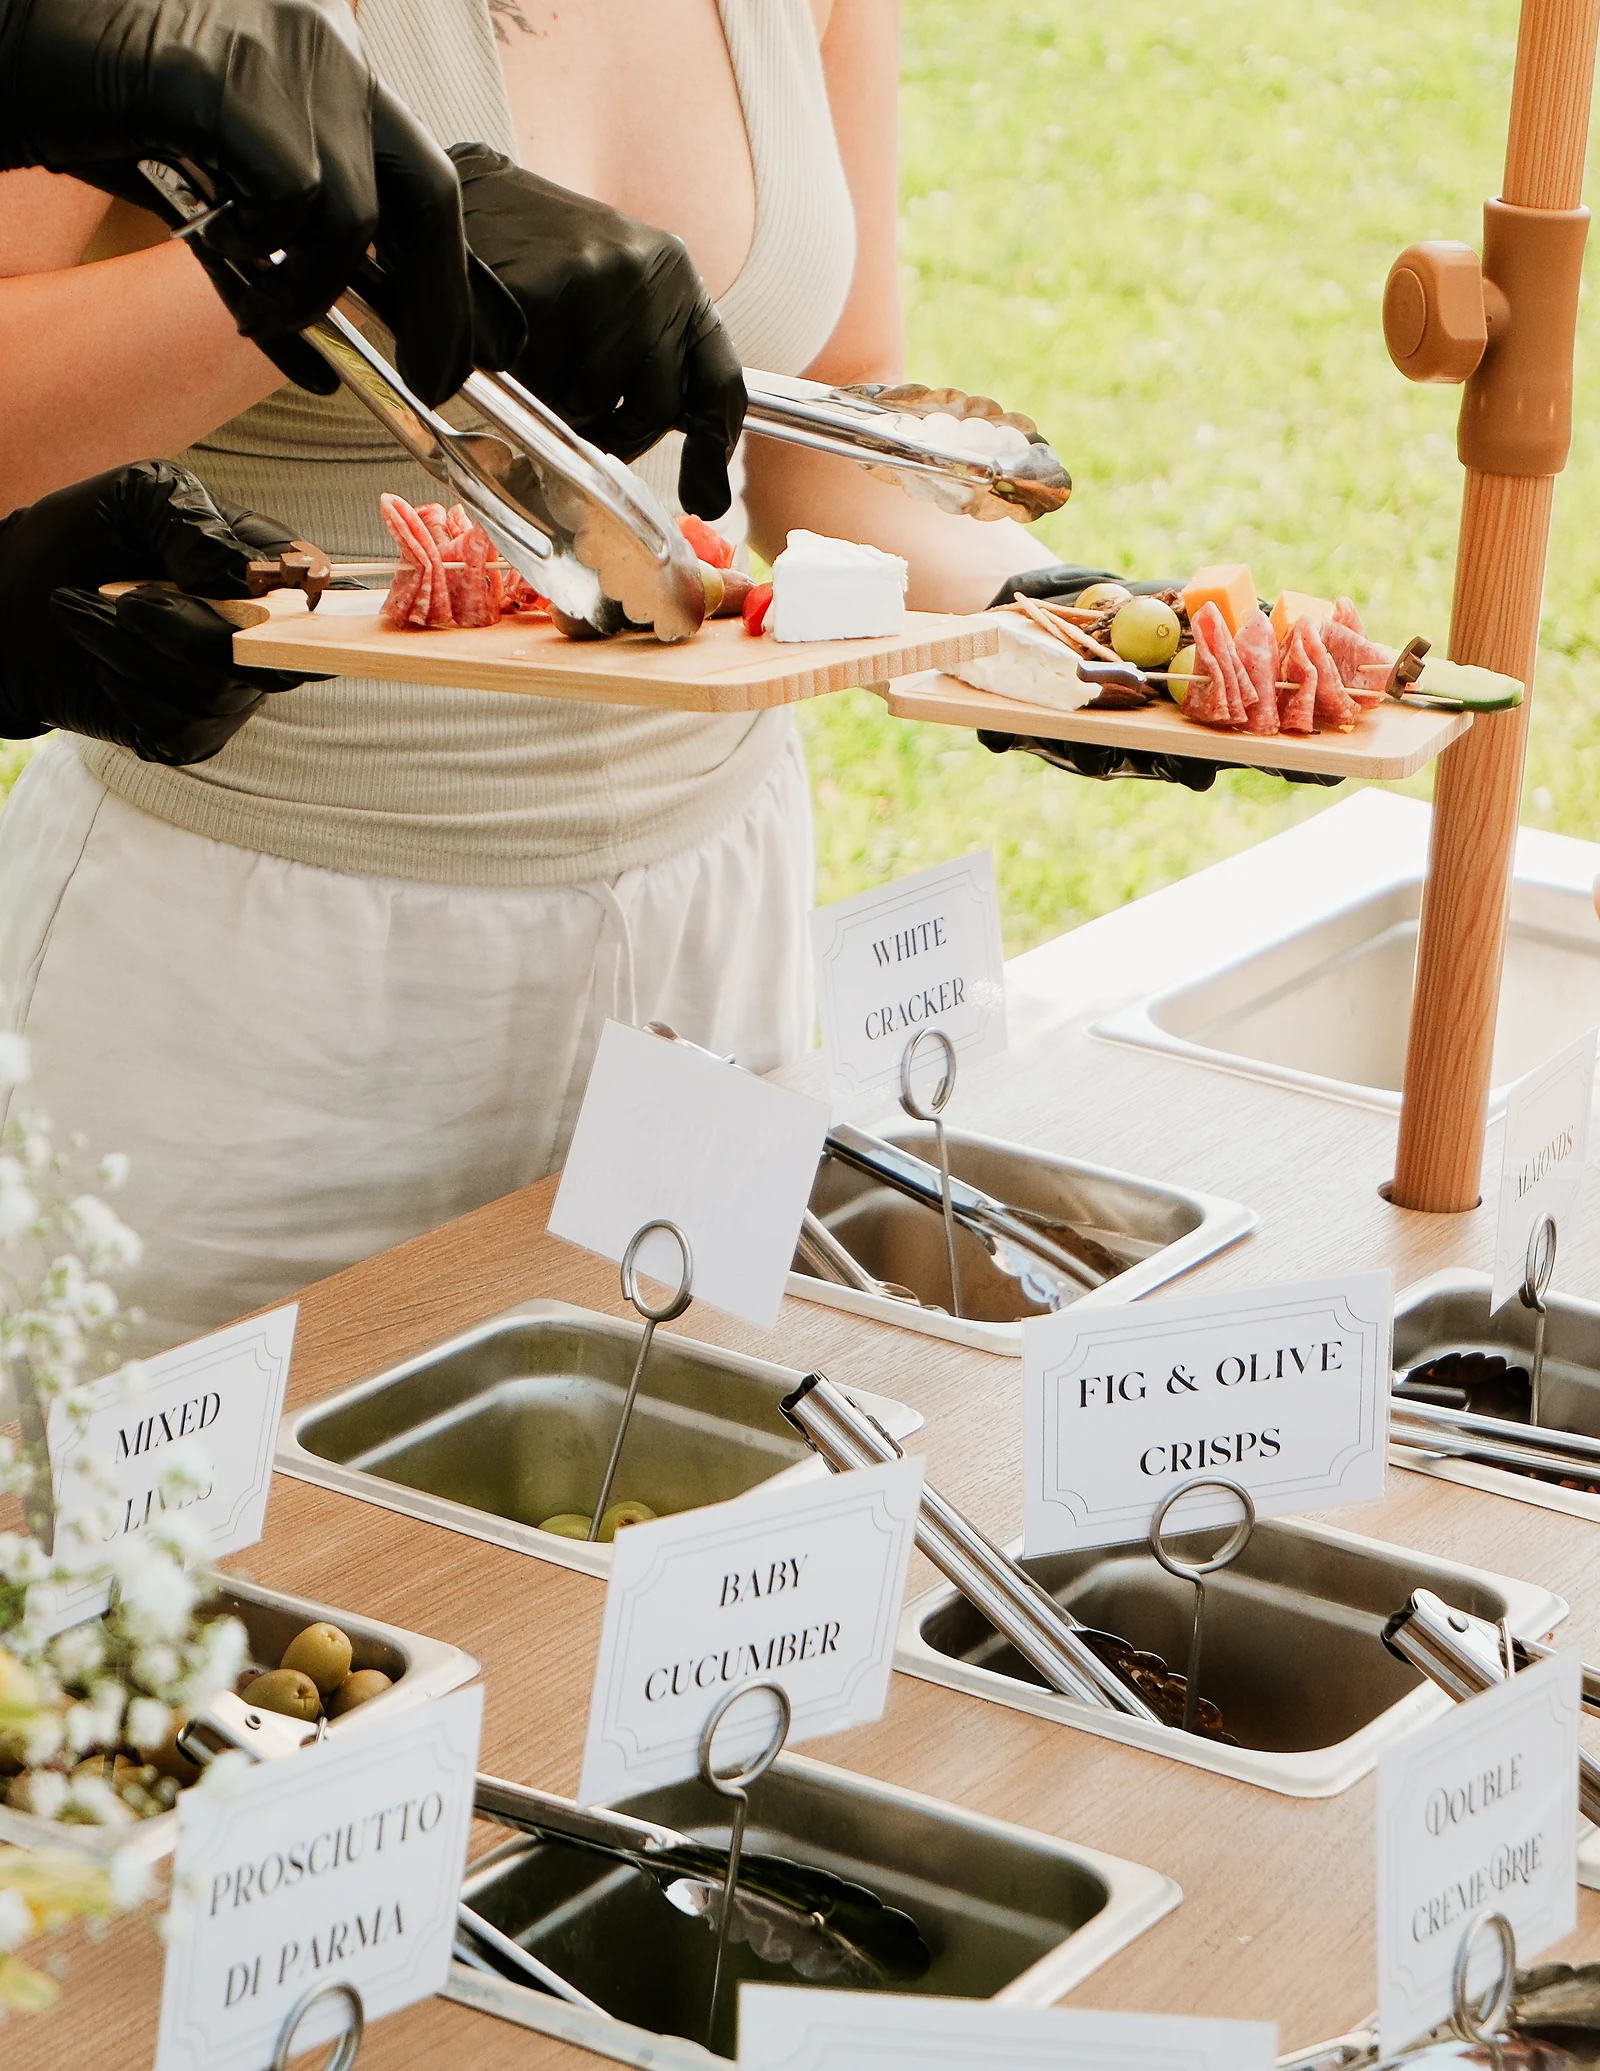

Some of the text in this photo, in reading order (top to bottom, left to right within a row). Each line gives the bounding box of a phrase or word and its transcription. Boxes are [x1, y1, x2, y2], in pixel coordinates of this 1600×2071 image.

[871, 916, 947, 967] WHITE
[865, 976, 965, 1041] CRACKER
[1514, 1125, 1574, 1202] ALMONDS
[1079, 1341, 1343, 1408] FIG & OLIVE
[114, 1391, 222, 1464] MIXED
[1139, 1427, 1281, 1476] CRISPS
[718, 1553, 808, 1608] BABY
[644, 1620, 841, 1702] CUCUMBER
[1425, 1753, 1524, 1836] DOUBLE
[209, 1790, 443, 1917] PROSCIUTTO
[224, 1900, 405, 2008] DI PARMA
